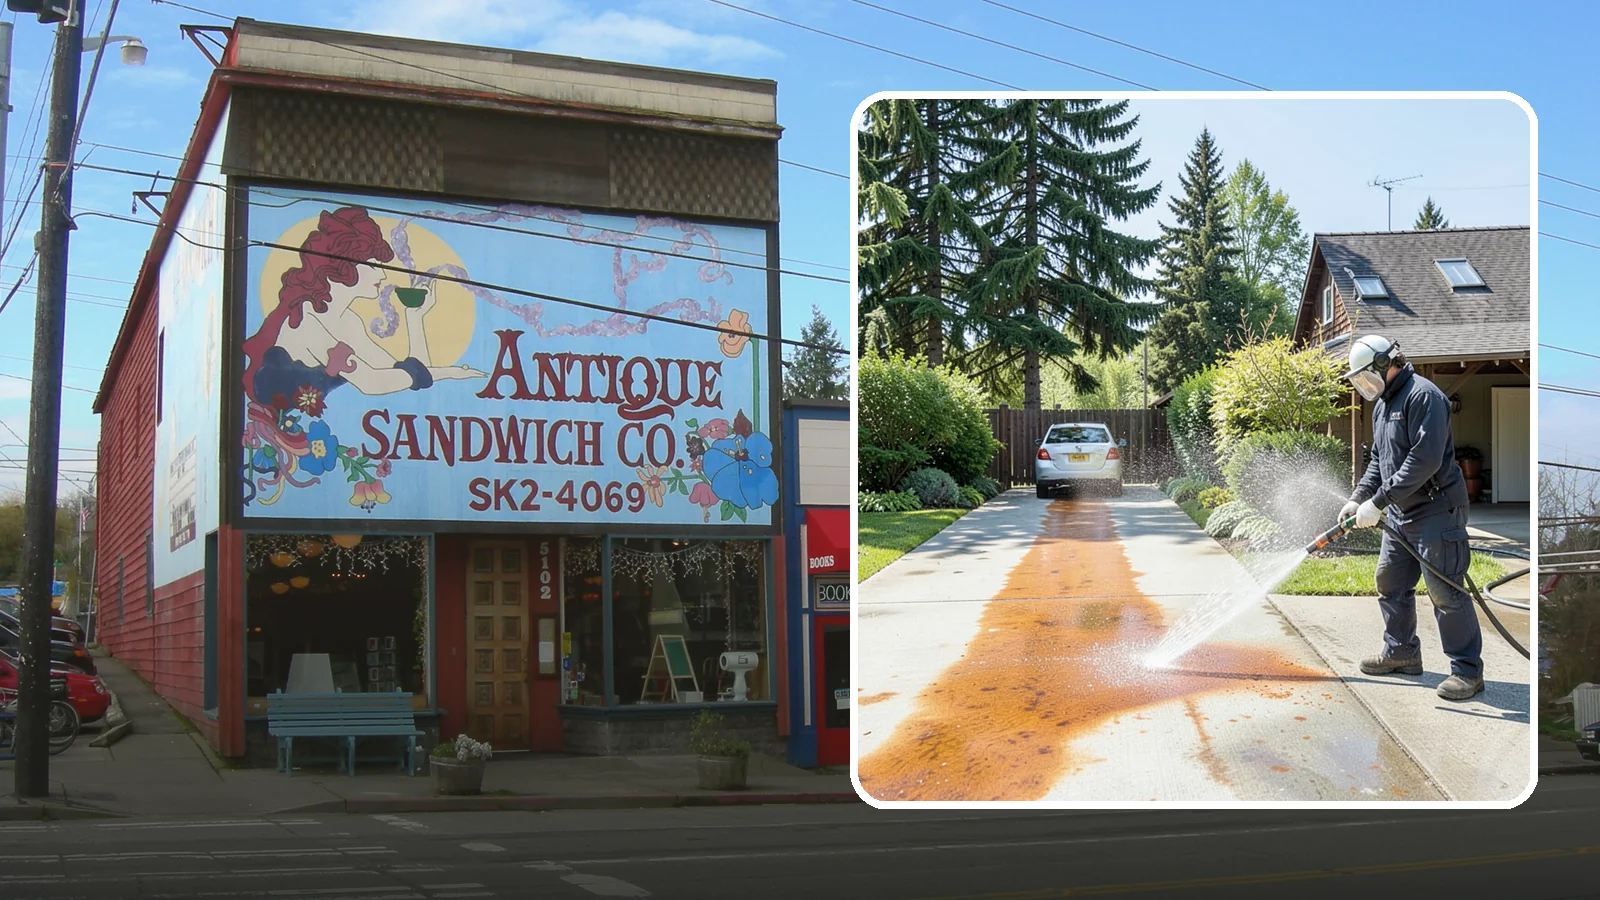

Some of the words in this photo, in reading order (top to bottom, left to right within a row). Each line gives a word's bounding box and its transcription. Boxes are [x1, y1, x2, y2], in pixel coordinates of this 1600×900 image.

[475, 328, 724, 421] ANTIQUE
[361, 408, 604, 467] SANDWICH
[617, 421, 685, 468] CO.
[468, 476, 646, 513] SK2-4069
[540, 541, 552, 600] 5102
[809, 555, 835, 569] BOOKS
